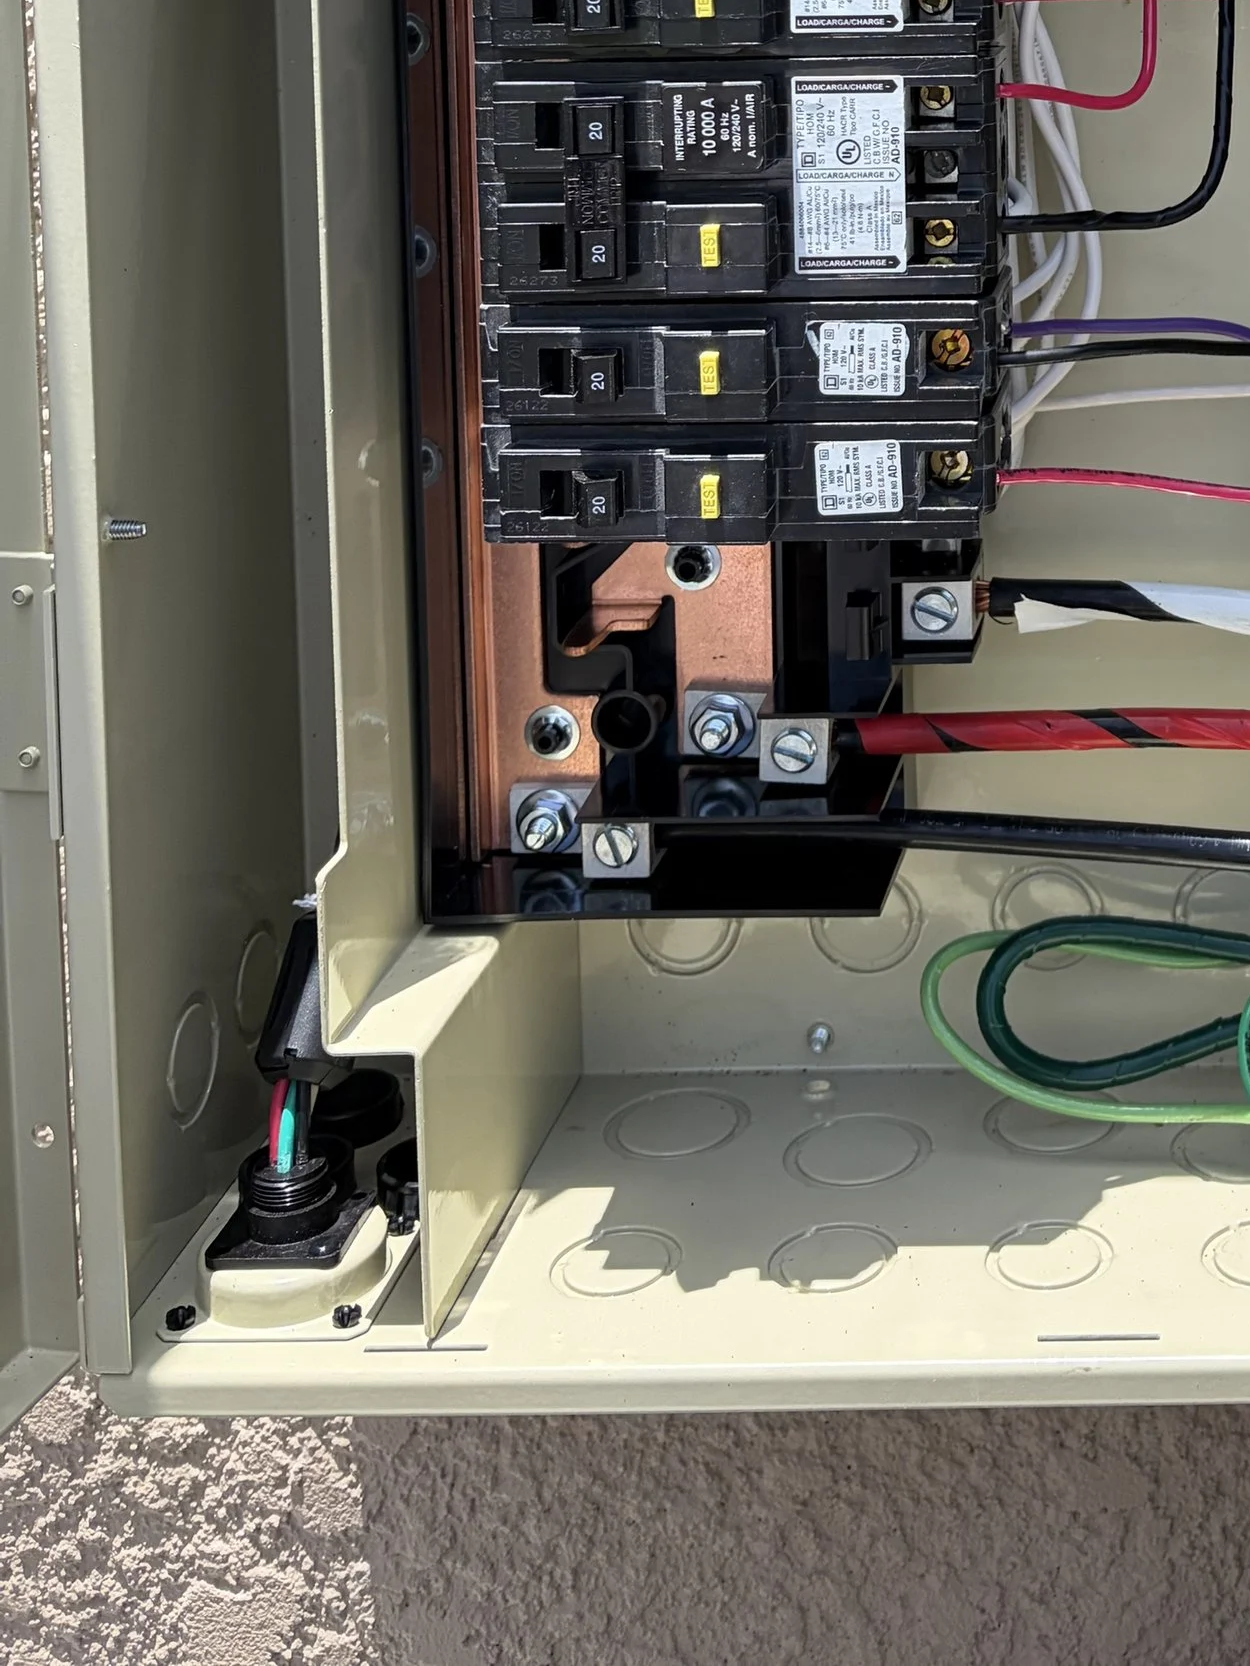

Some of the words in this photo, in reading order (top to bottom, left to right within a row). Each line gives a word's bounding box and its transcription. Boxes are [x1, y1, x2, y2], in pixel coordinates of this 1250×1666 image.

[797, 18, 885, 26] LOAD/CARGA/CHARGE
[797, 83, 884, 91] LOAD/CARGA/CHARGE
[700, 98, 715, 108] A
[701, 111, 716, 136] 000
[720, 112, 729, 126] Hz
[796, 99, 804, 149] TYPE/TIPO
[806, 113, 814, 134] HOM
[827, 110, 835, 122] Hz
[588, 121, 603, 141] 20
[673, 94, 685, 161] INTERRUPTING
[686, 110, 696, 144] RATING
[720, 128, 730, 141] 60
[731, 114, 741, 152] 120/240
[748, 122, 756, 147] nom.
[817, 112, 825, 148] 120/240
[826, 125, 835, 136] 60
[702, 139, 717, 156] 10
[747, 150, 756, 158] A
[863, 136, 871, 164] LISTED
[891, 127, 900, 164] AD-910
[592, 244, 606, 265] 20
[703, 231, 716, 263] TEST
[801, 259, 887, 267] LOAD/CARGA/CHARGE
[892, 327, 902, 362] AD-910
[591, 372, 605, 390] 20
[703, 357, 717, 391] TEST
[886, 442, 898, 478] AD-910
[592, 496, 606, 514] 20
[703, 482, 717, 516] TEST
[878, 489, 886, 509] LISTED
